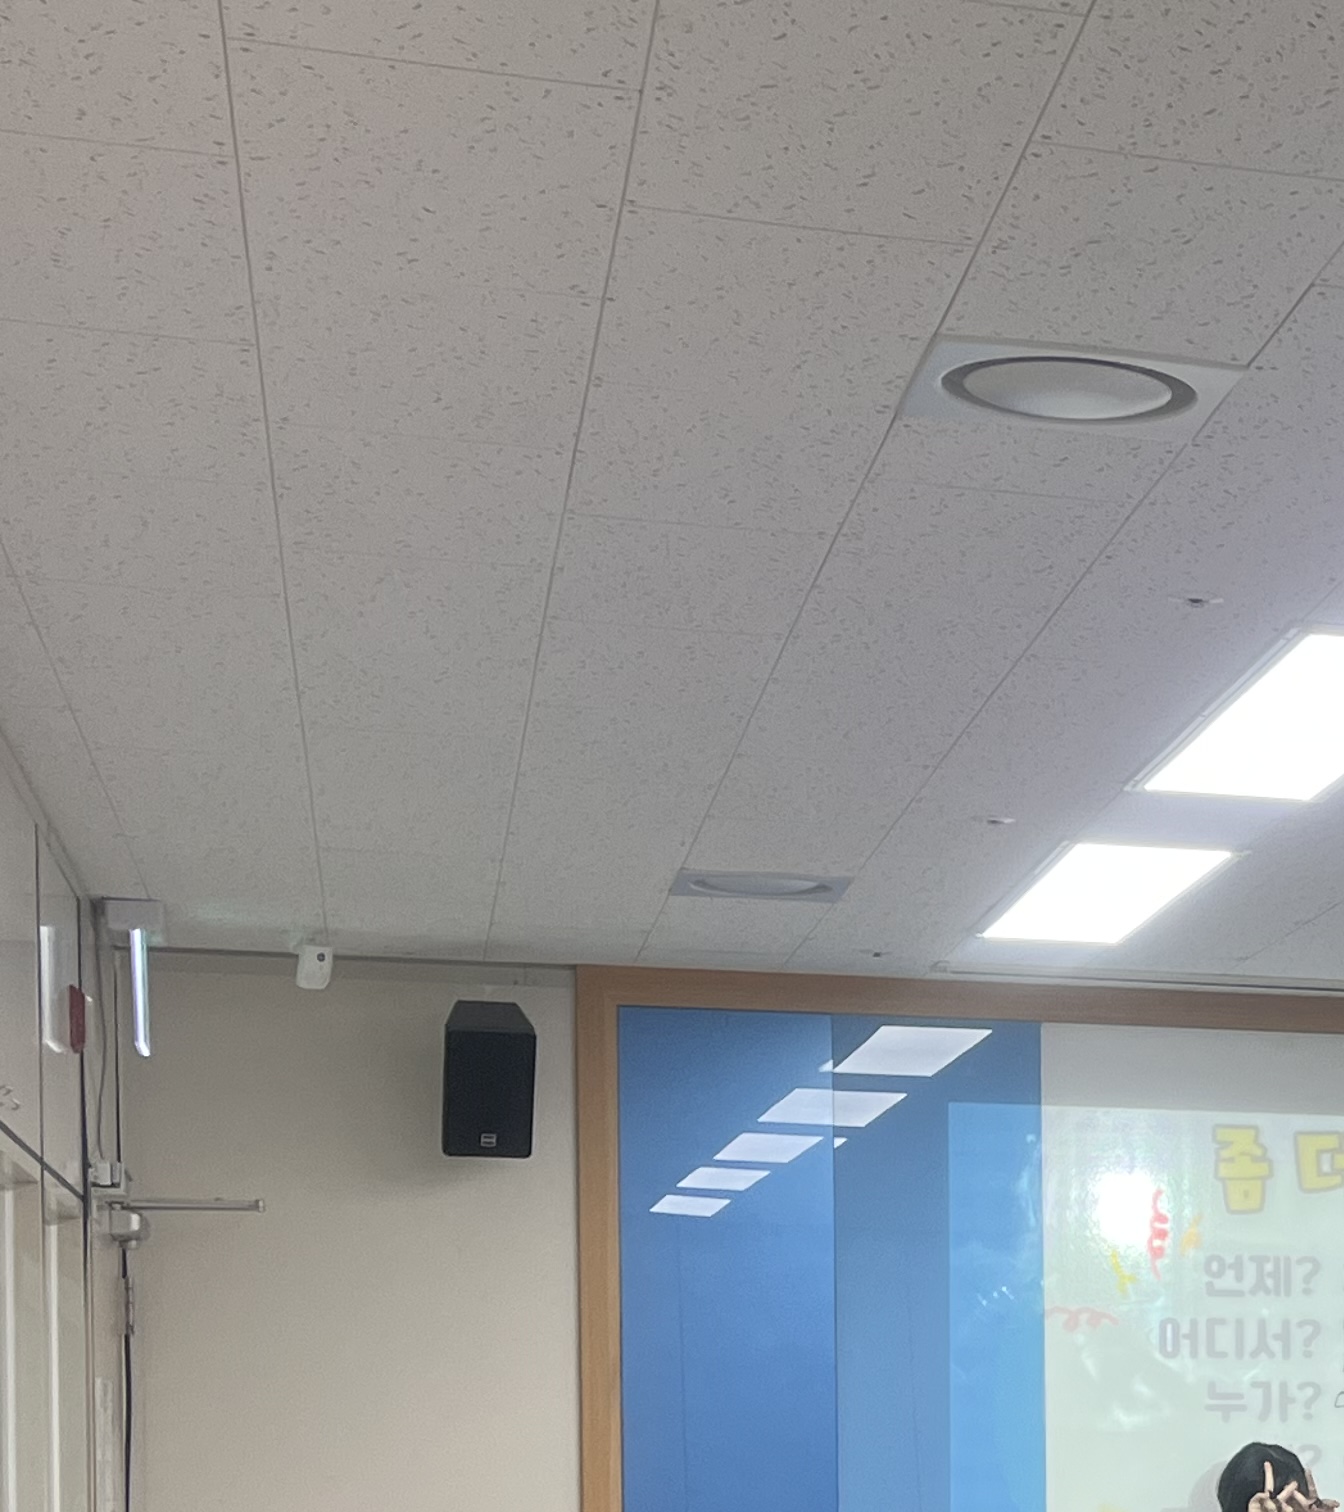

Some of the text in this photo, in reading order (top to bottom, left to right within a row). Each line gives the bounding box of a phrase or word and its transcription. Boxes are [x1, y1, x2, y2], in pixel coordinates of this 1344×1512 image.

[1213, 1124, 1273, 1214] 좀
[1204, 1253, 1321, 1299] 언제?
[1159, 1317, 1322, 1360] 어디서?
[1206, 1380, 1322, 1423] 누가?
